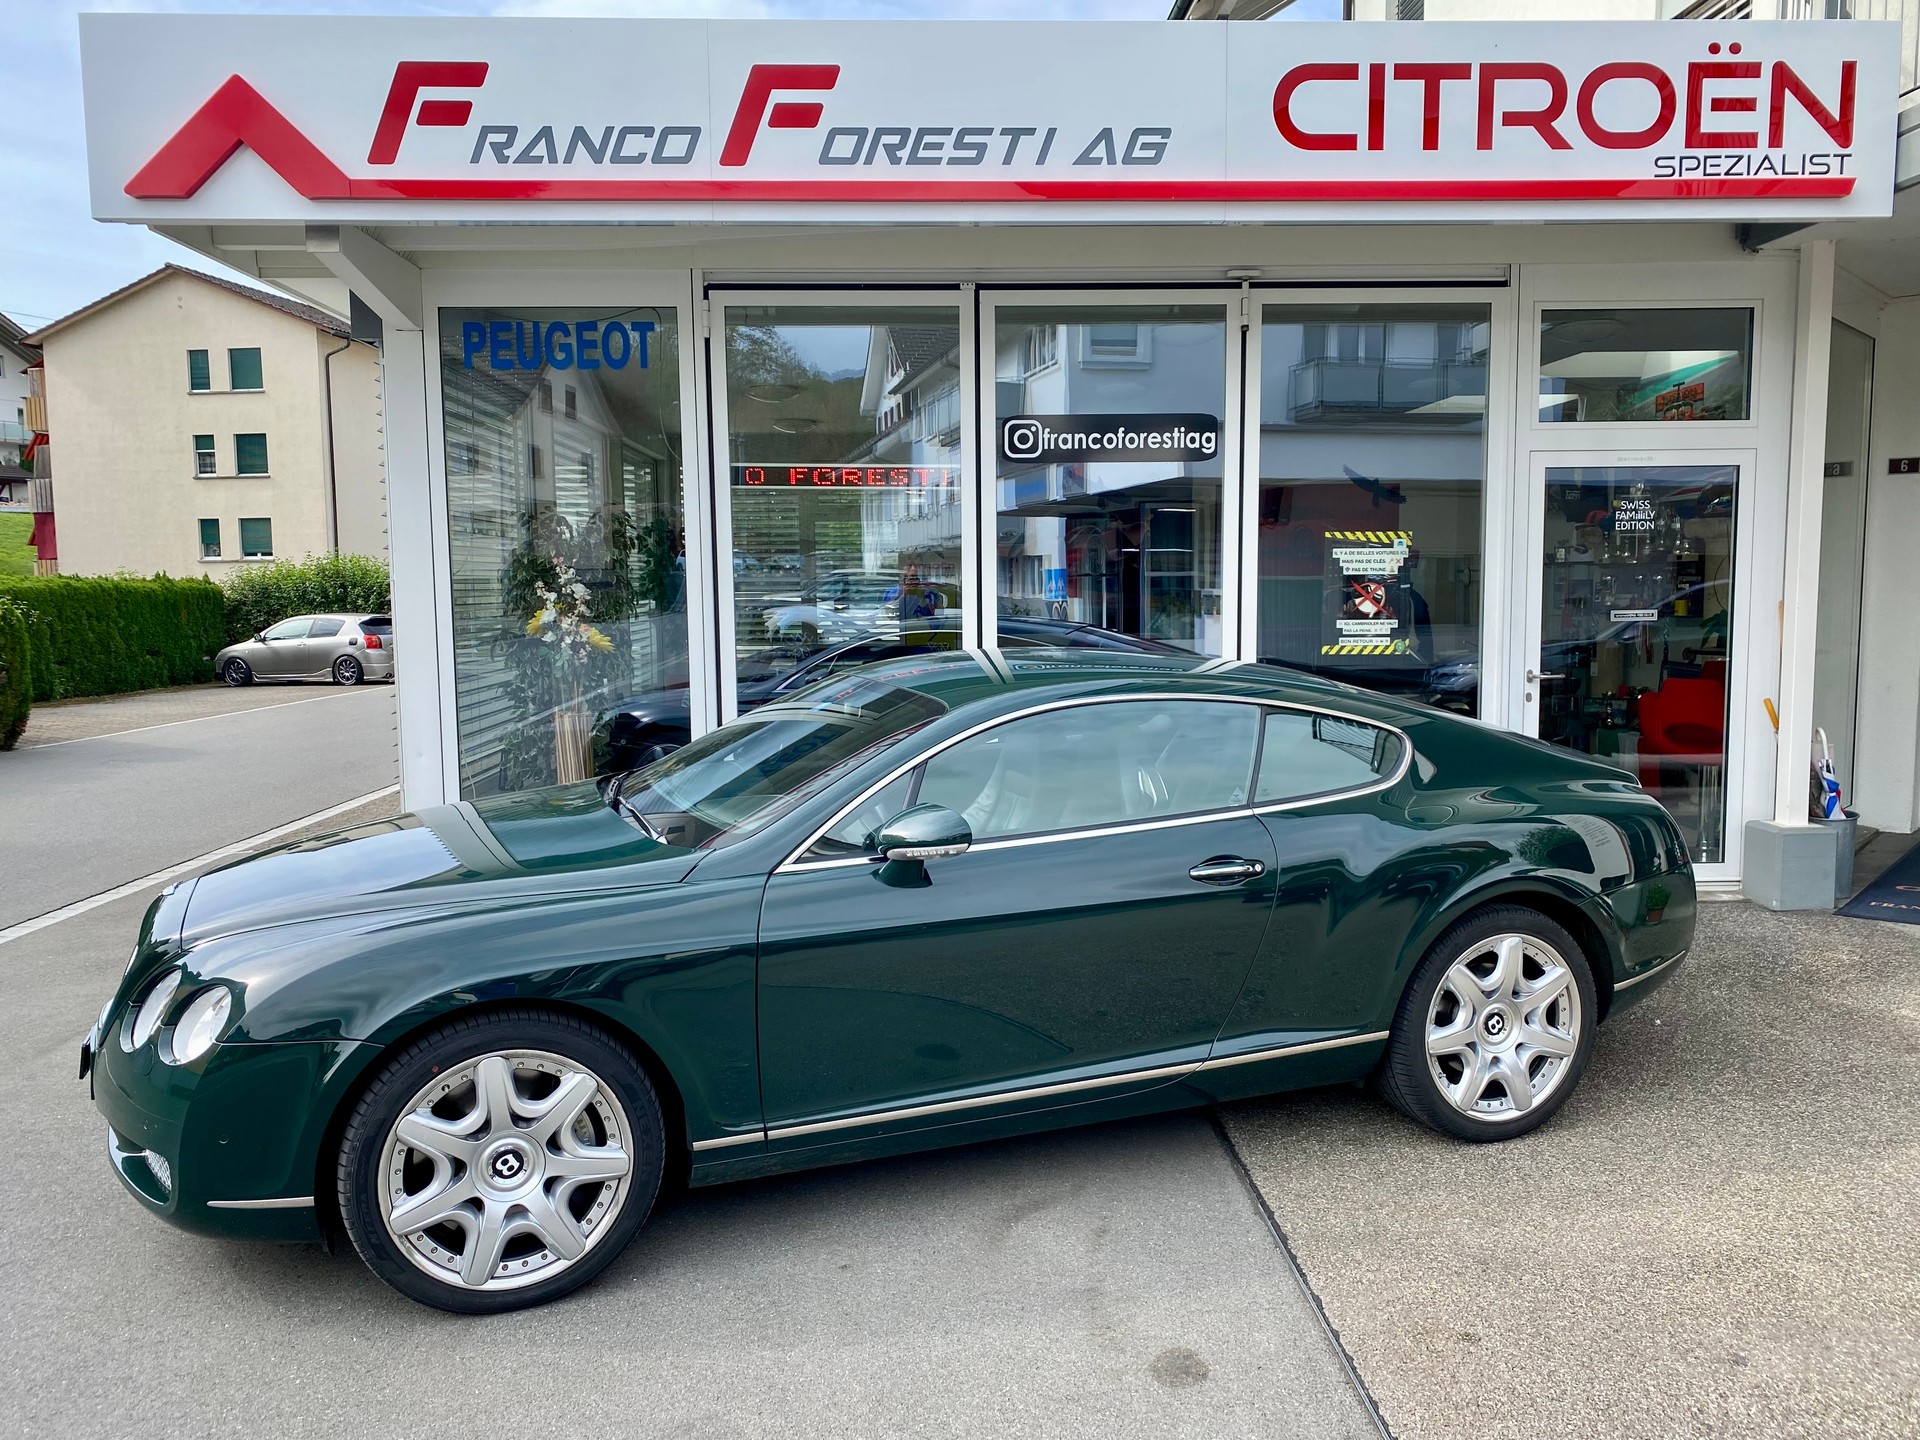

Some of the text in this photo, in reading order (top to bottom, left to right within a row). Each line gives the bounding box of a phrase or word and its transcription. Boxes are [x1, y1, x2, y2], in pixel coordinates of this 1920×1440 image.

[1273, 42, 1857, 151] CITROËN
[367, 61, 1172, 167] FRANCO FORESTI AG
[1654, 153, 1853, 178] SPEZIALIST
[462, 321, 655, 371] PEUGEOT
[1043, 427, 1216, 454] francoforestiag
[1900, 460, 1909, 471] 6
[1620, 500, 1651, 510] SWISS
[1615, 520, 1655, 531] EDITION
